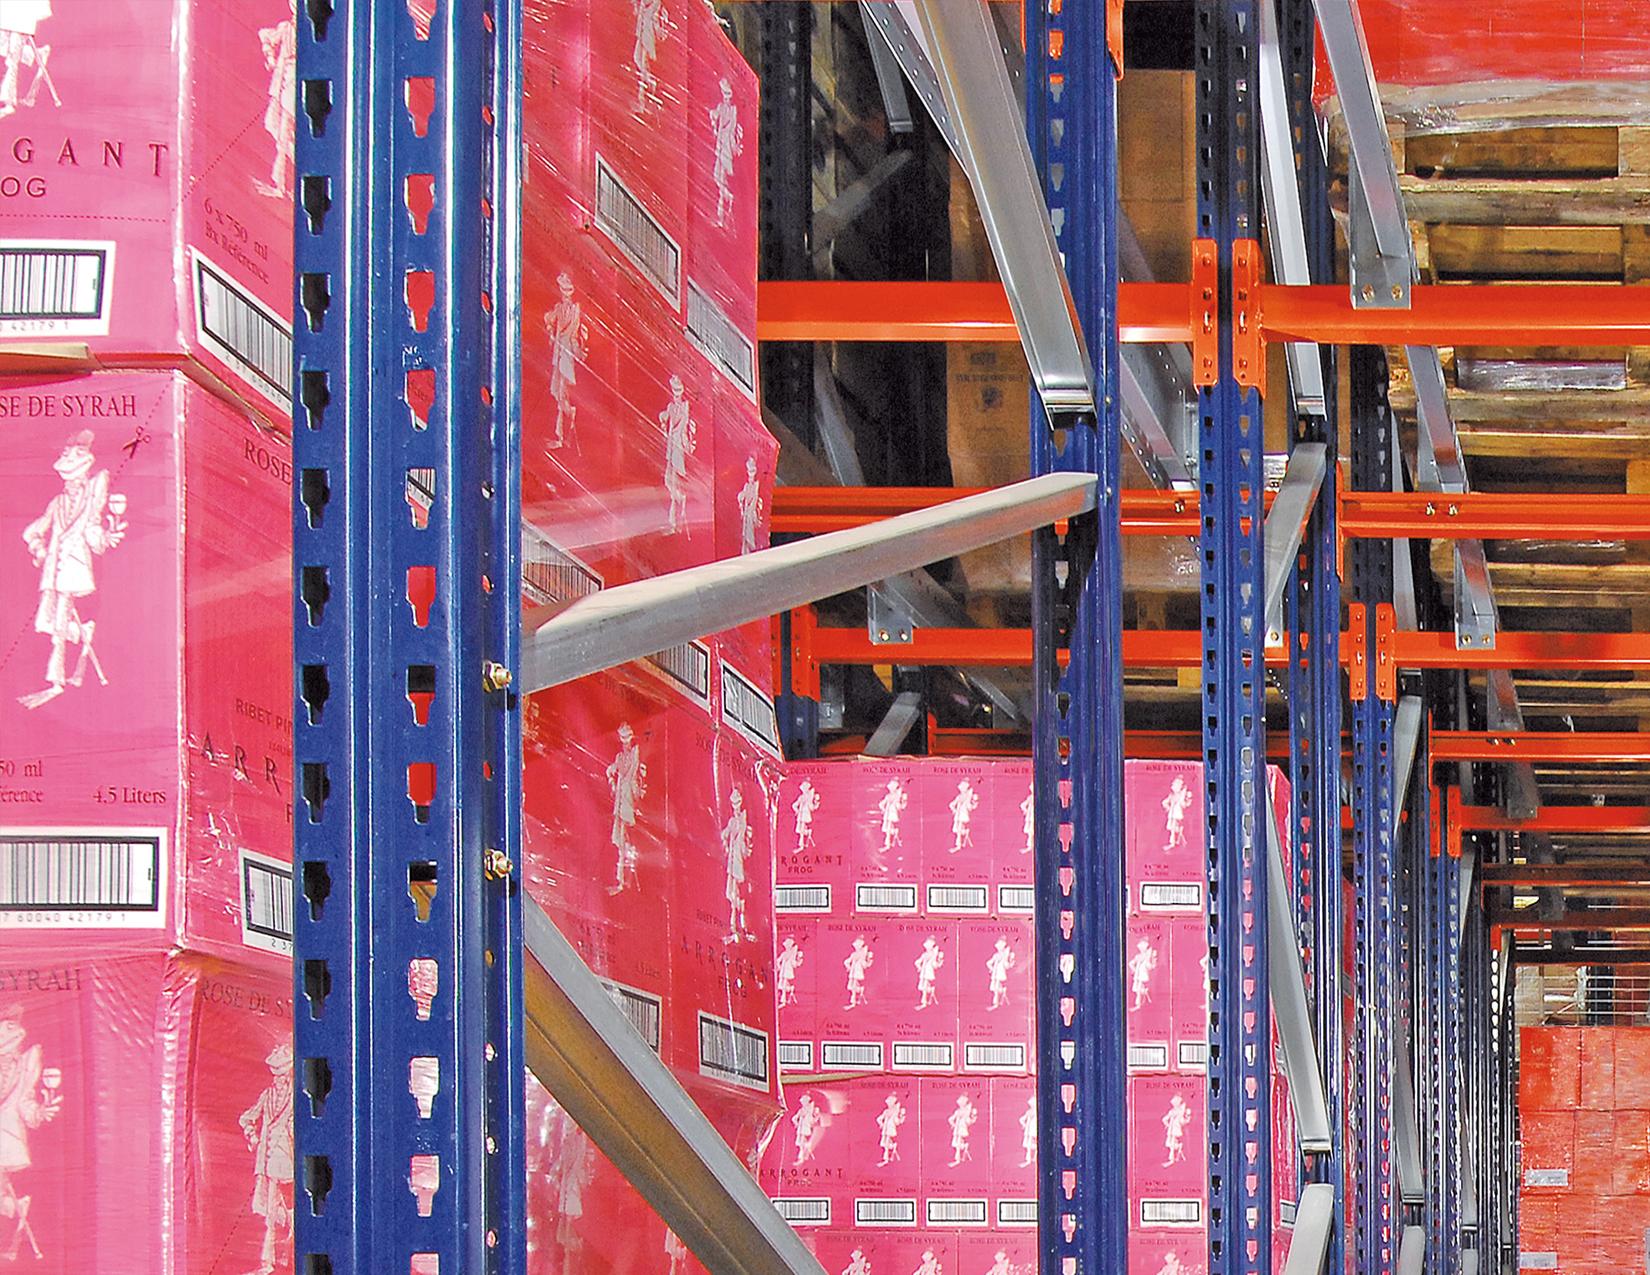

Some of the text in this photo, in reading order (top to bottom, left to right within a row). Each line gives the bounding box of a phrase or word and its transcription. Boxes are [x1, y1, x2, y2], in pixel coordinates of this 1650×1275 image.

[28, 395, 55, 417] DE
[62, 395, 137, 417] SYRAH
[244, 438, 292, 485] ROSE
[25, 760, 42, 777] ml
[123, 787, 167, 804] Liters
[788, 866, 813, 874] FROG
